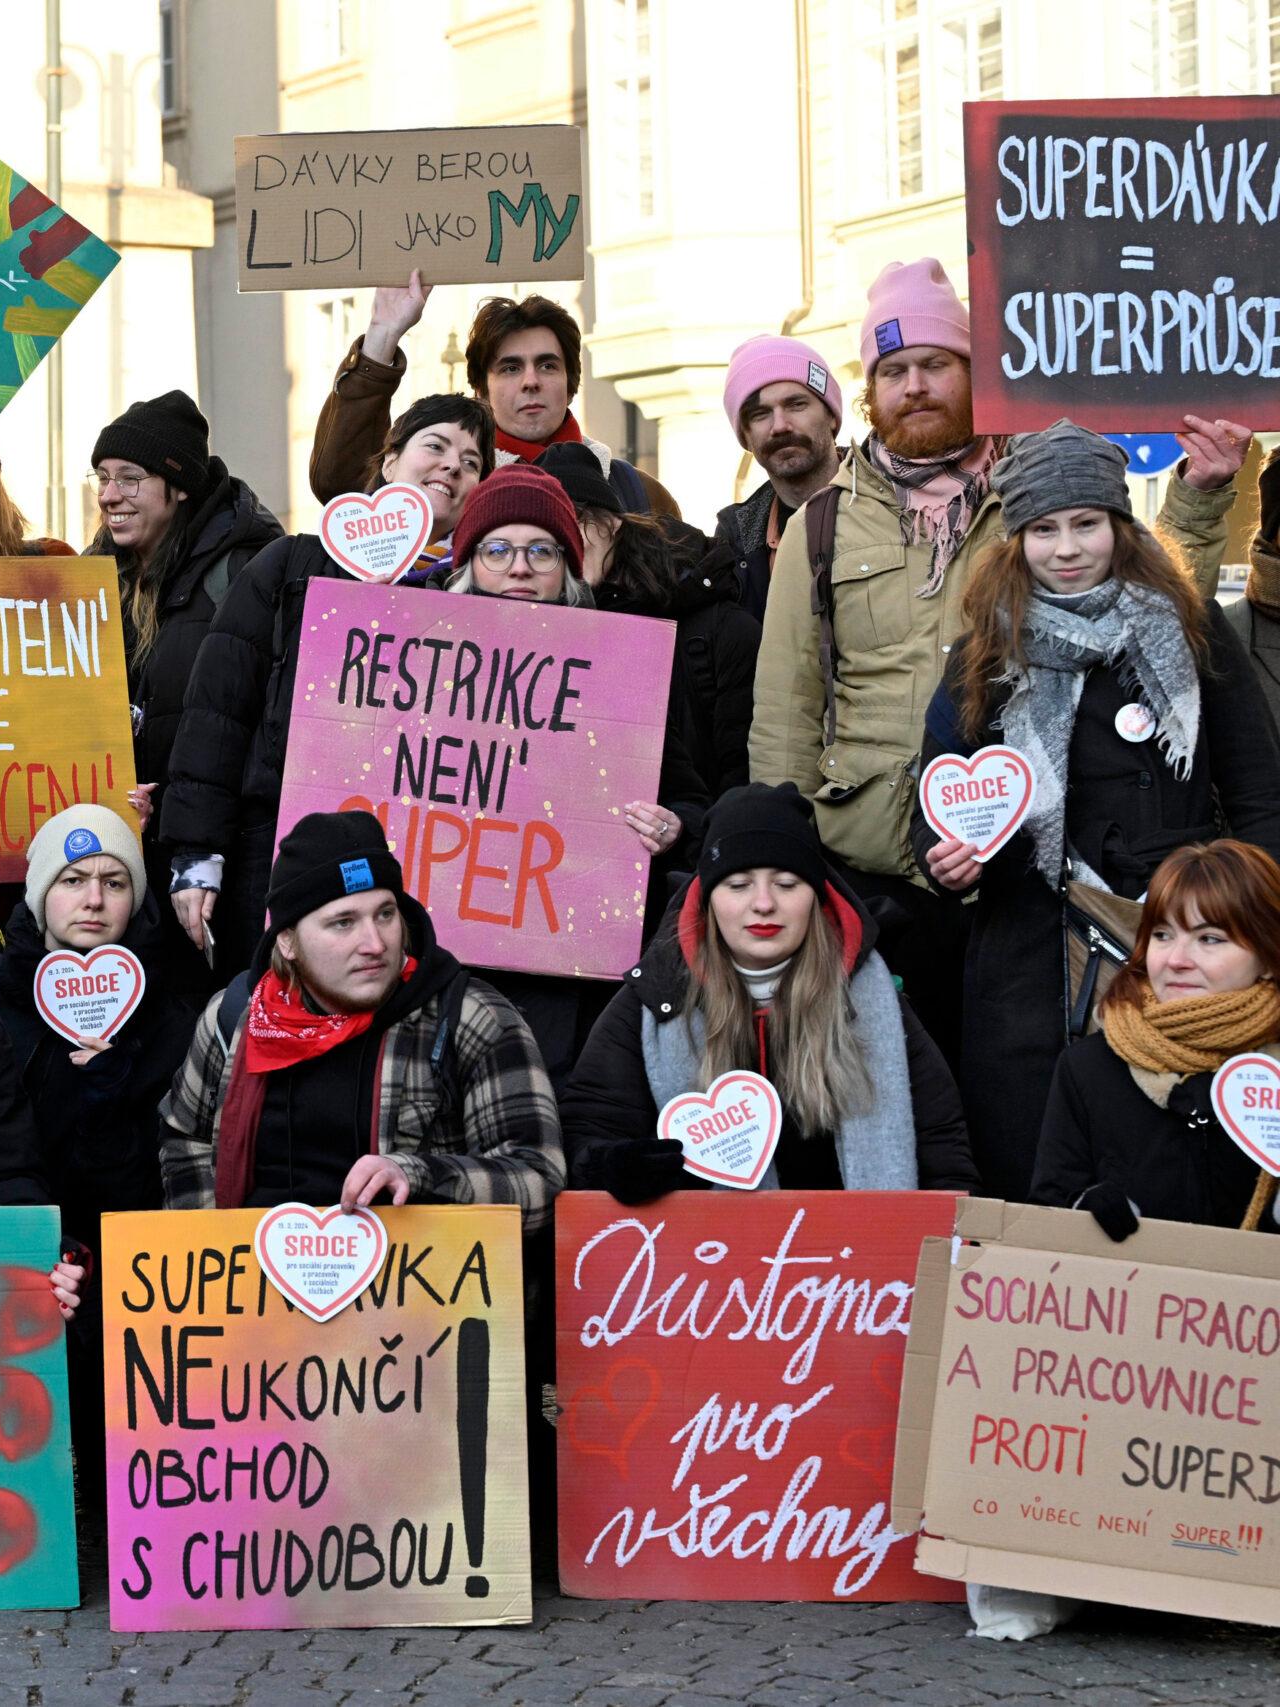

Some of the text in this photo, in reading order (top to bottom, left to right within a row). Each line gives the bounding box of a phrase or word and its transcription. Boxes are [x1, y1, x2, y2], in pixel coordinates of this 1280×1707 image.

[254, 151, 533, 191] DÁVKY BEROU
[247, 183, 580, 271] LIDI JAKO MY
[344, 509, 409, 541] SRDCE
[338, 628, 592, 732] RESTRIKCE
[941, 776, 1009, 806] SRDCE
[55, 973, 120, 999] SRDCE
[686, 1099, 756, 1145] SRDCE
[284, 1235, 358, 1257] SRDCE
[121, 1240, 492, 1317] SUPEVKA
[954, 1261, 1139, 1335] SOCIÁLNÍ
[947, 1344, 1261, 1426] A PRACOVNICE
[670, 1384, 834, 1491] pro
[970, 1414, 1090, 1476] PROTI
[128, 1441, 329, 1509] OBCHOD
[584, 1456, 923, 1596] všechny
[973, 1498, 998, 1515] CO
[1020, 1496, 1081, 1527] VŮBEC
[1097, 1509, 1152, 1537] NENÍ
[121, 1537, 152, 1600] S
